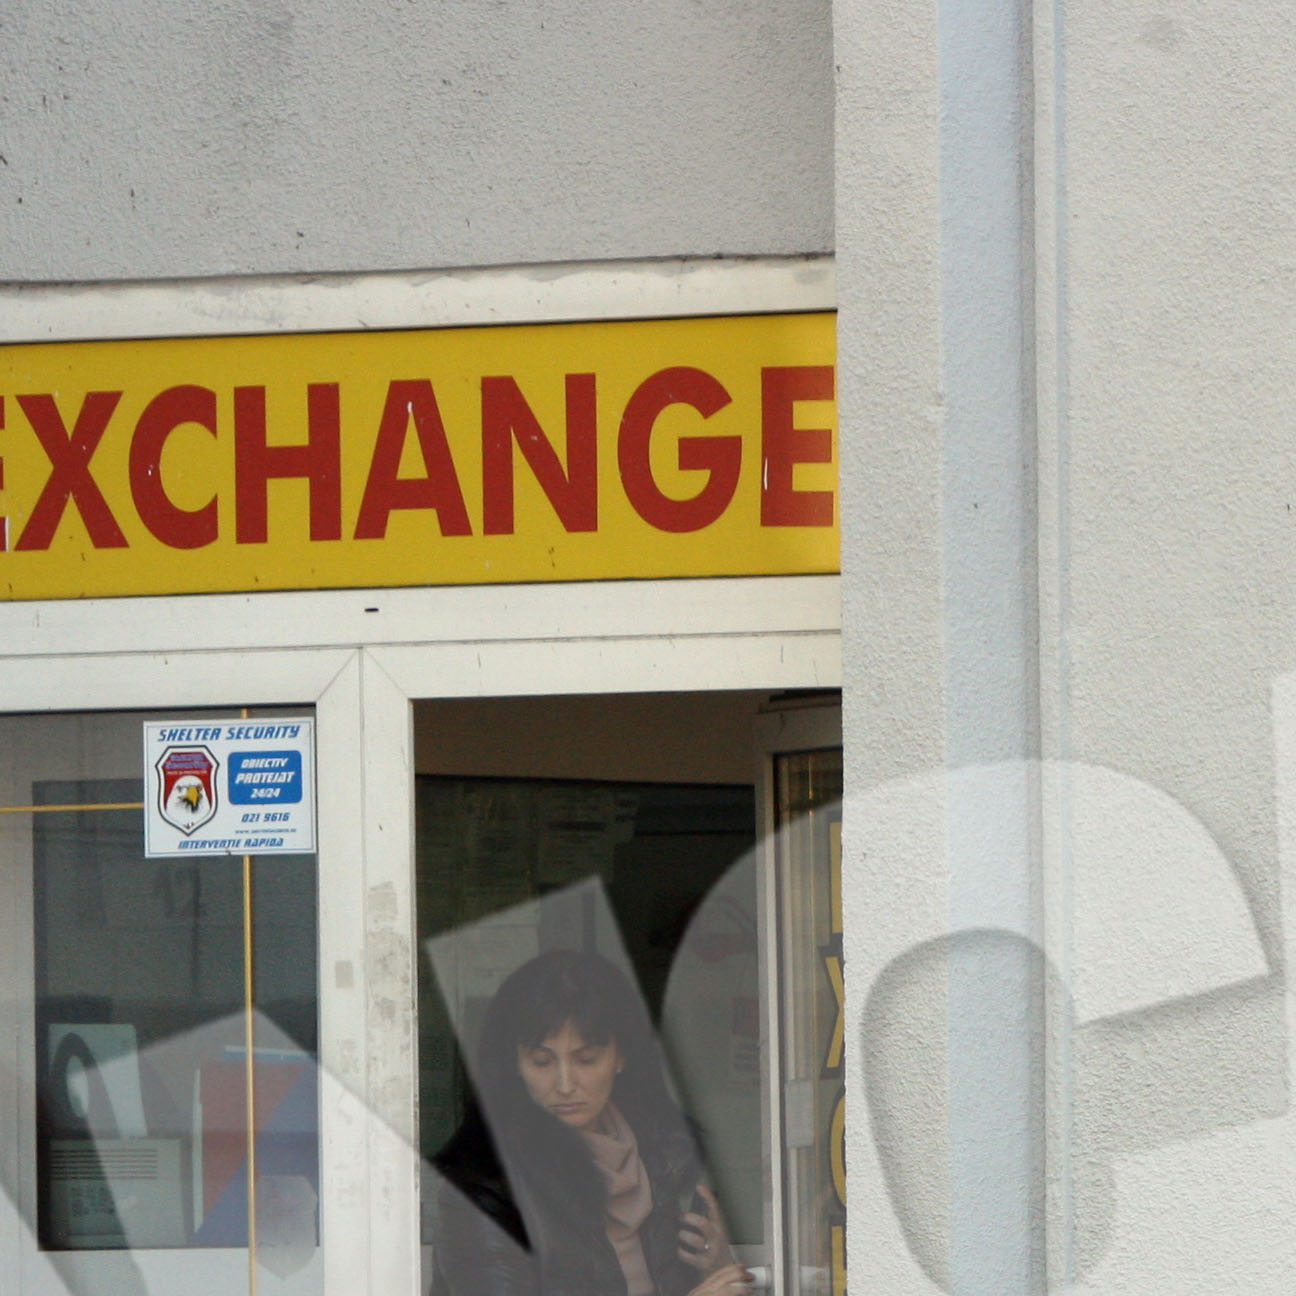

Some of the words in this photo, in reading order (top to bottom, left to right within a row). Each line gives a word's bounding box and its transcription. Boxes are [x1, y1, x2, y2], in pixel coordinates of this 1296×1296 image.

[158, 727, 222, 742] SHELTER
[226, 725, 301, 740] SECURITY
[241, 813, 260, 822] 021
